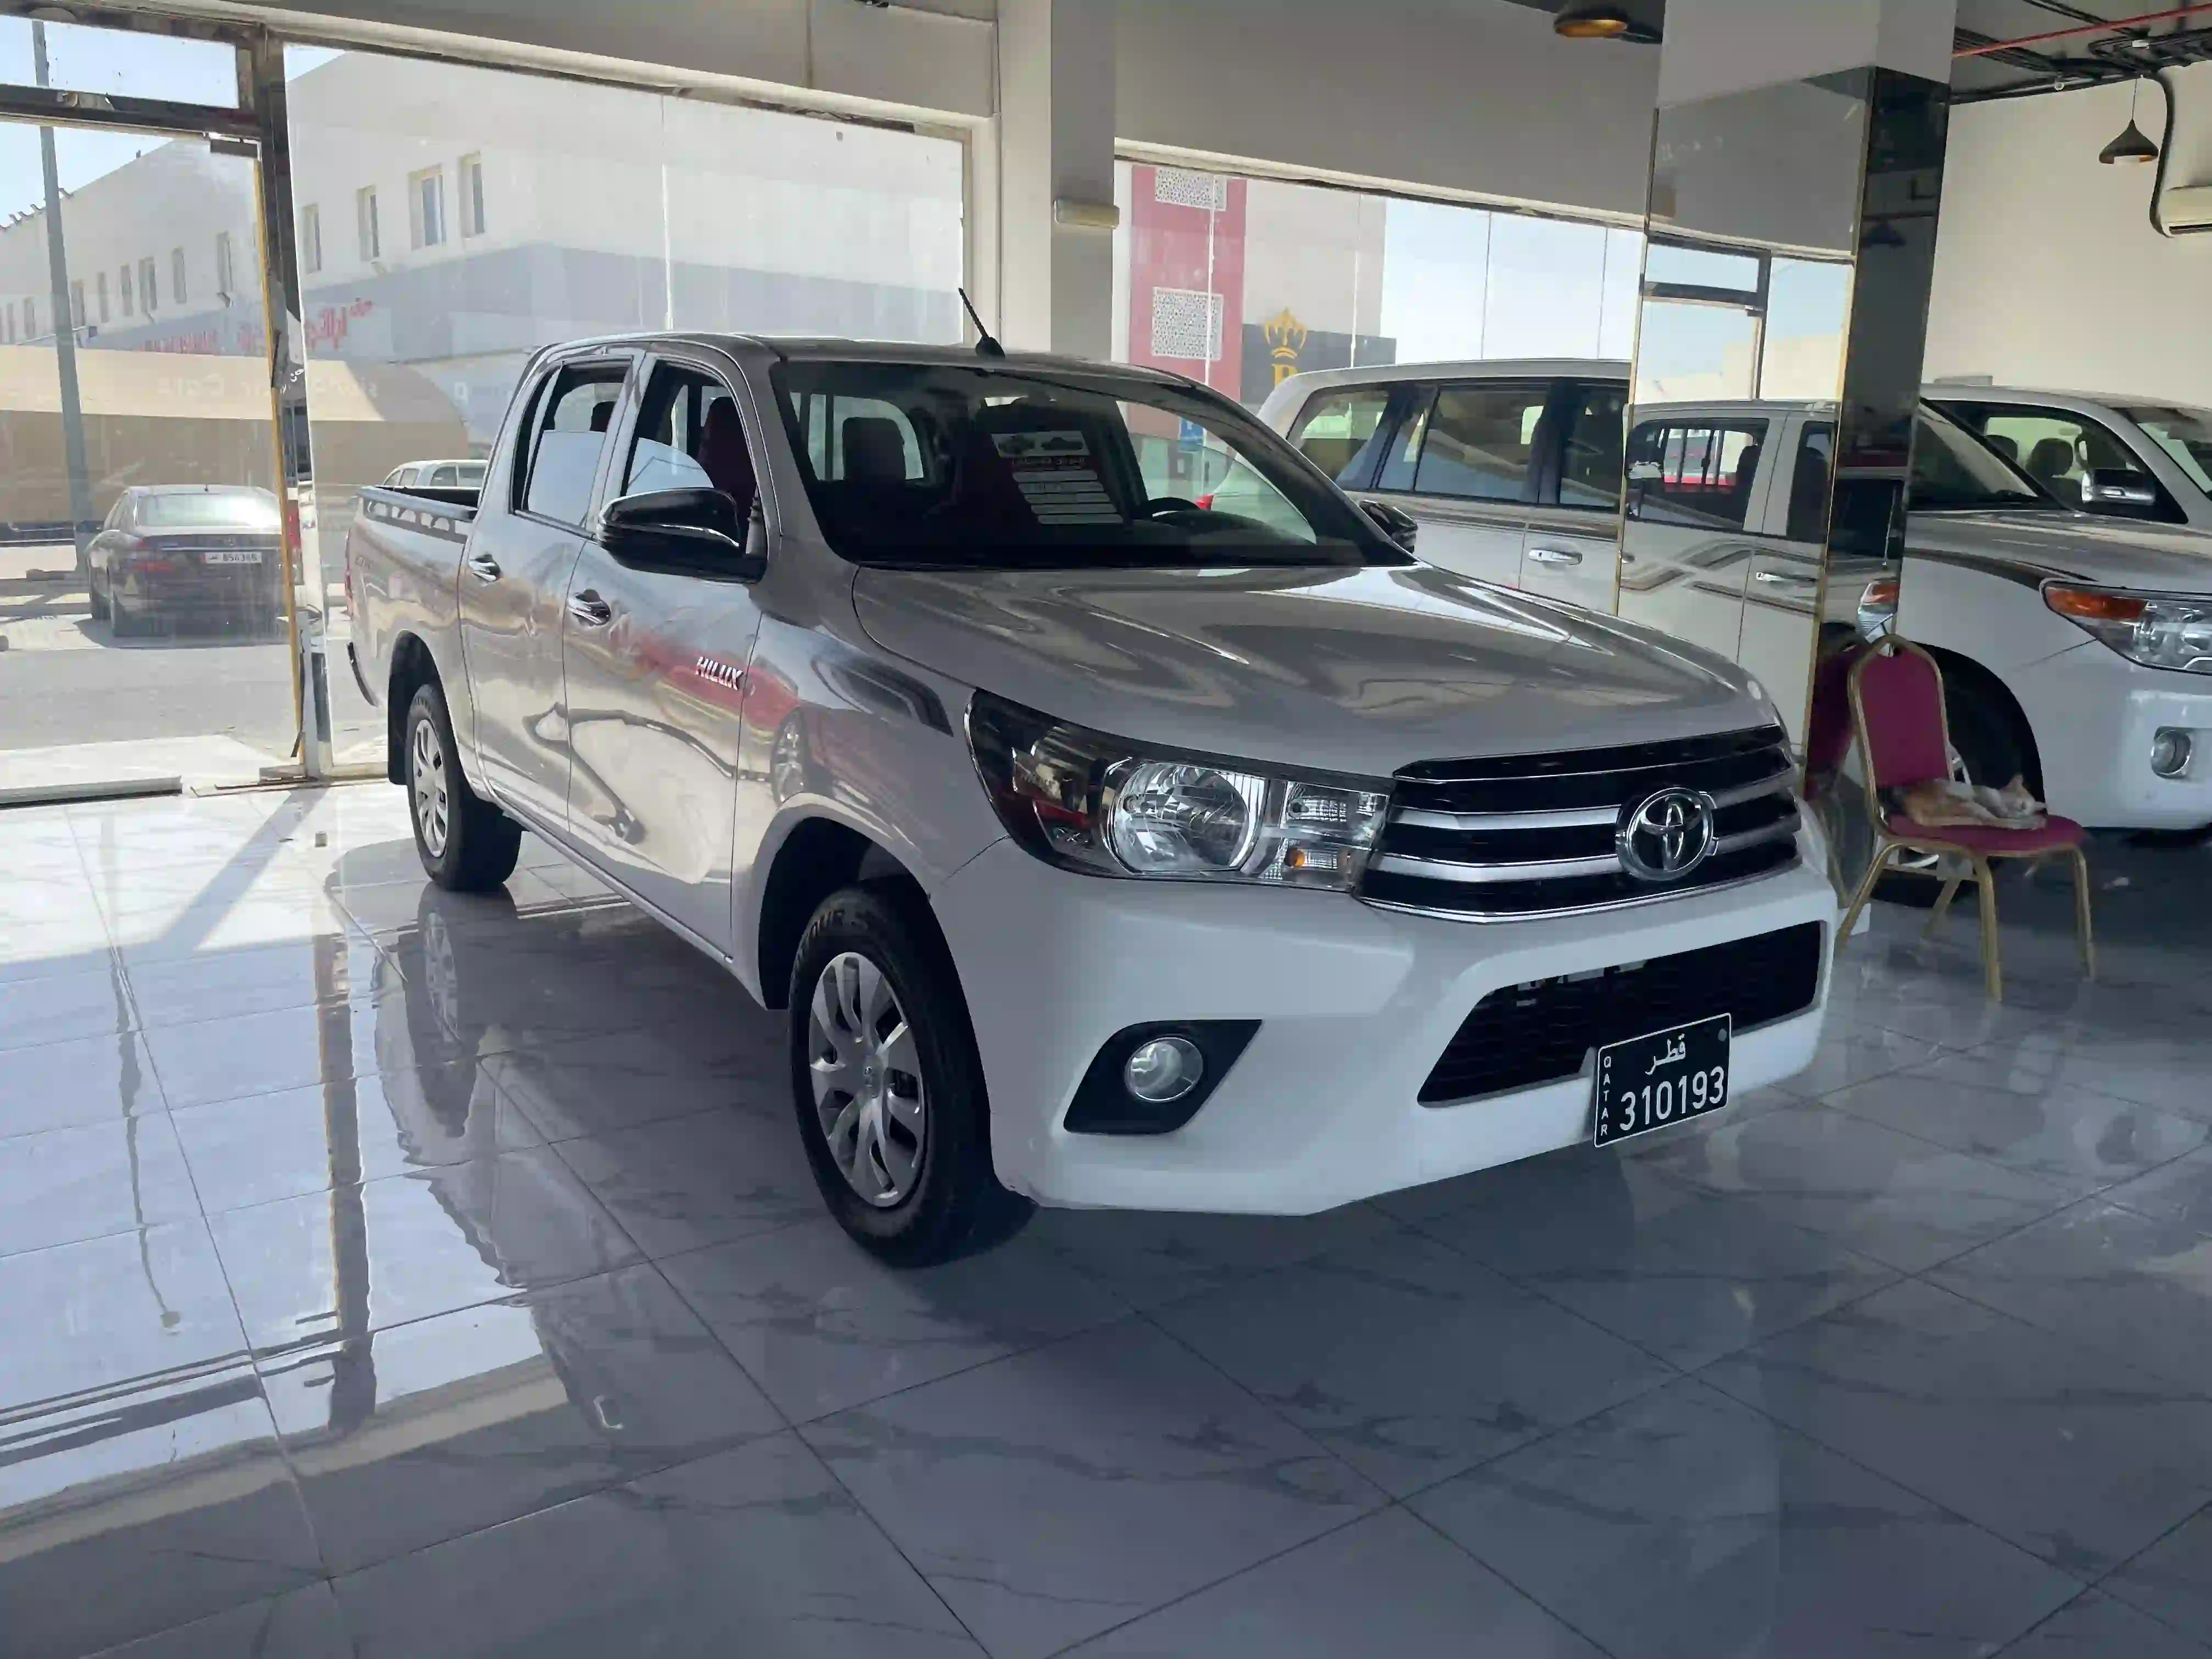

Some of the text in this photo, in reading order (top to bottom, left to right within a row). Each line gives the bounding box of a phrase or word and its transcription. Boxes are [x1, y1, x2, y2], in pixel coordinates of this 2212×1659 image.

[695, 656, 744, 691] HILUX
[1645, 1033, 1686, 1075] قطر
[1600, 1055, 1612, 1136] QATAR
[1619, 1065, 1724, 1131] 310193
